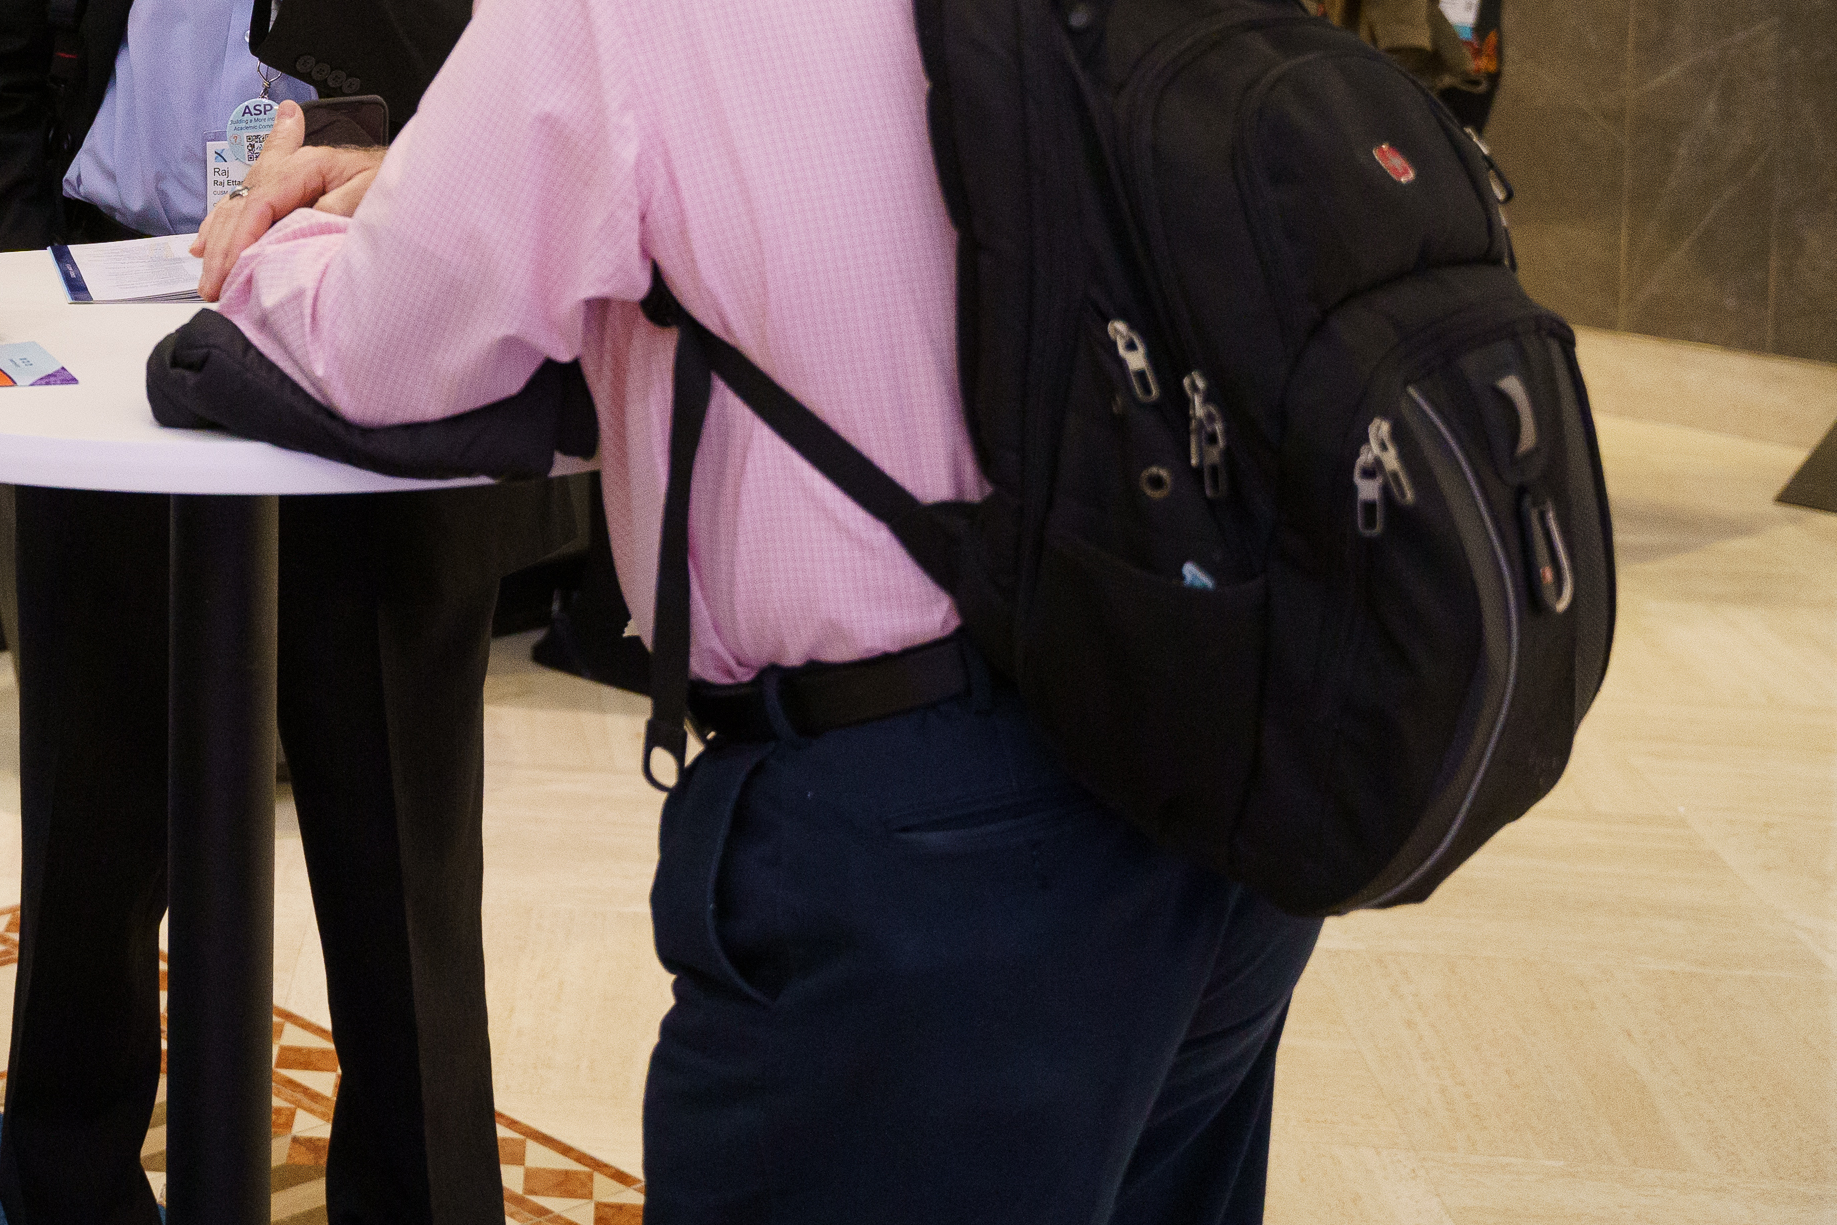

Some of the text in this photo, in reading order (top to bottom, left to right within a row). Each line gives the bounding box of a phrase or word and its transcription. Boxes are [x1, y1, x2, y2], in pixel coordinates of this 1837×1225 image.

[242, 103, 273, 117] ASP
[213, 167, 230, 179] Raj
[213, 179, 225, 187] Raj
